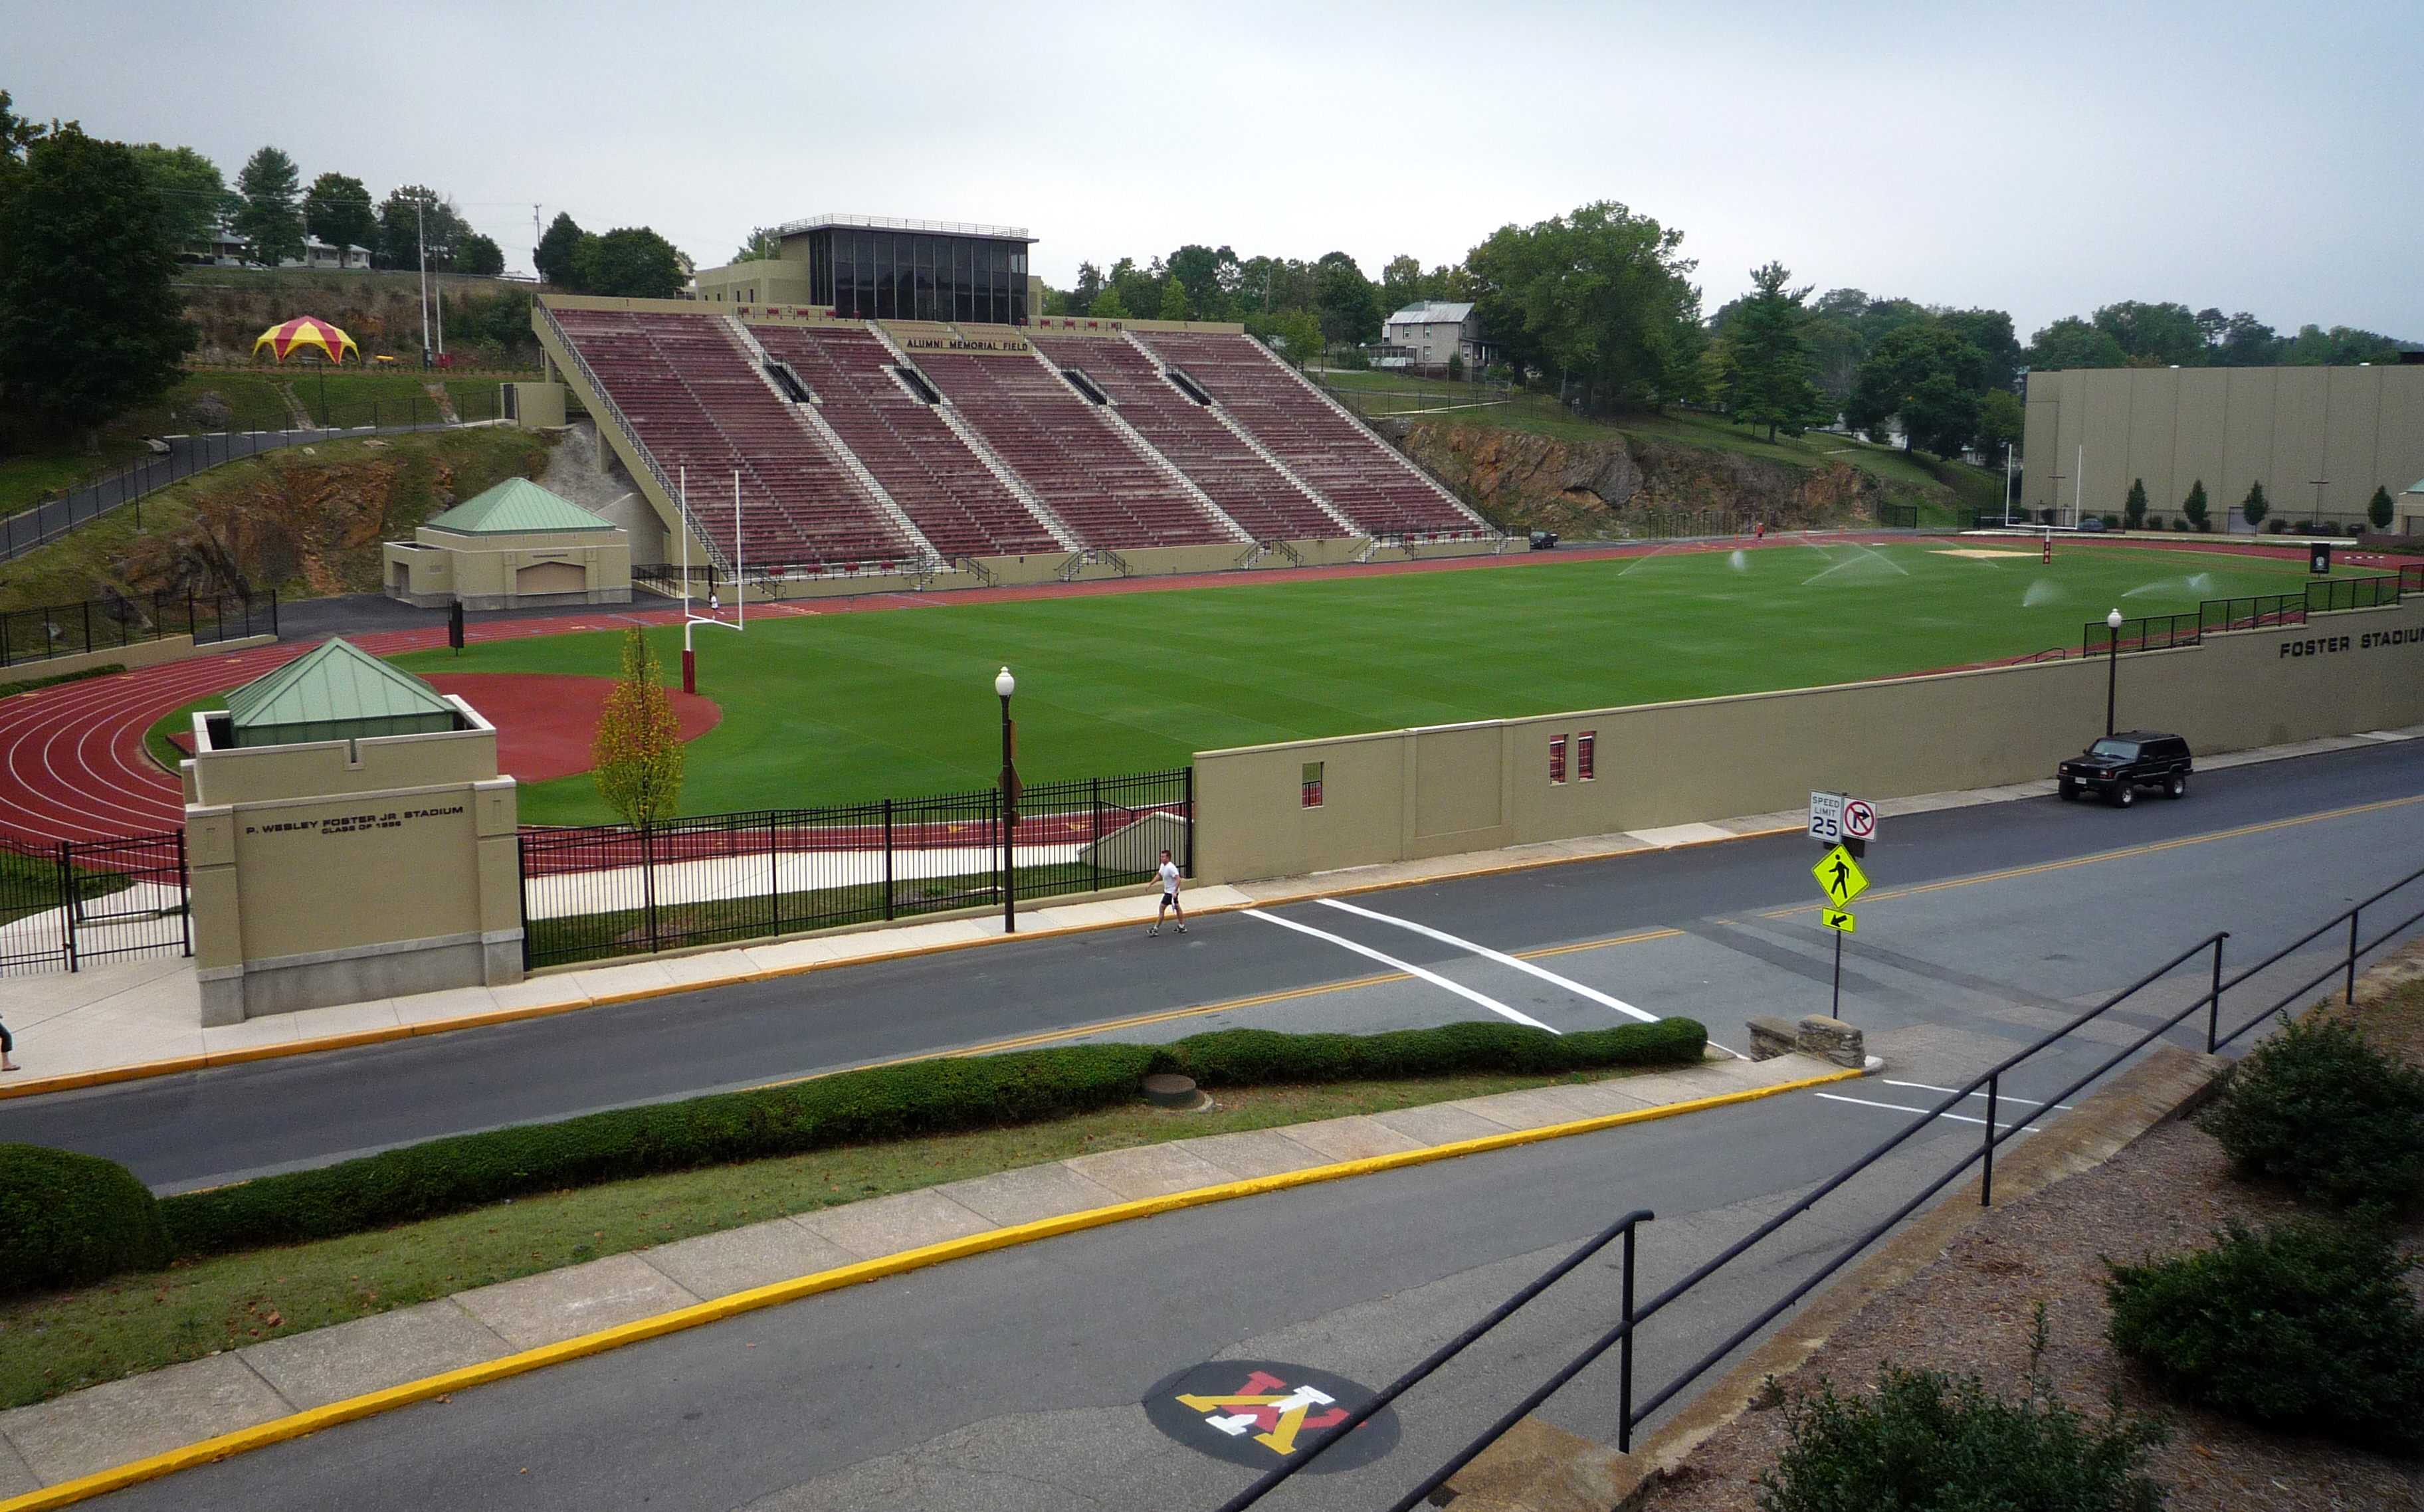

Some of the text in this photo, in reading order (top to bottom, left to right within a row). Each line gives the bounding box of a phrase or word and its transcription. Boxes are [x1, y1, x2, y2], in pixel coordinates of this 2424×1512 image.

[907, 339, 943, 348] ALUMNI
[950, 341, 998, 350] MEMORIAL
[2280, 636, 2350, 658] FOSTER
[1812, 797, 1839, 808] SPEED
[1815, 806, 1835, 816] LIMIT
[262, 820, 318, 833] WESLEY
[322, 814, 376, 826] FOSTER
[404, 806, 463, 818] STADIUM
[322, 825, 355, 834] CLASS
[1812, 816, 1837, 836] 25
